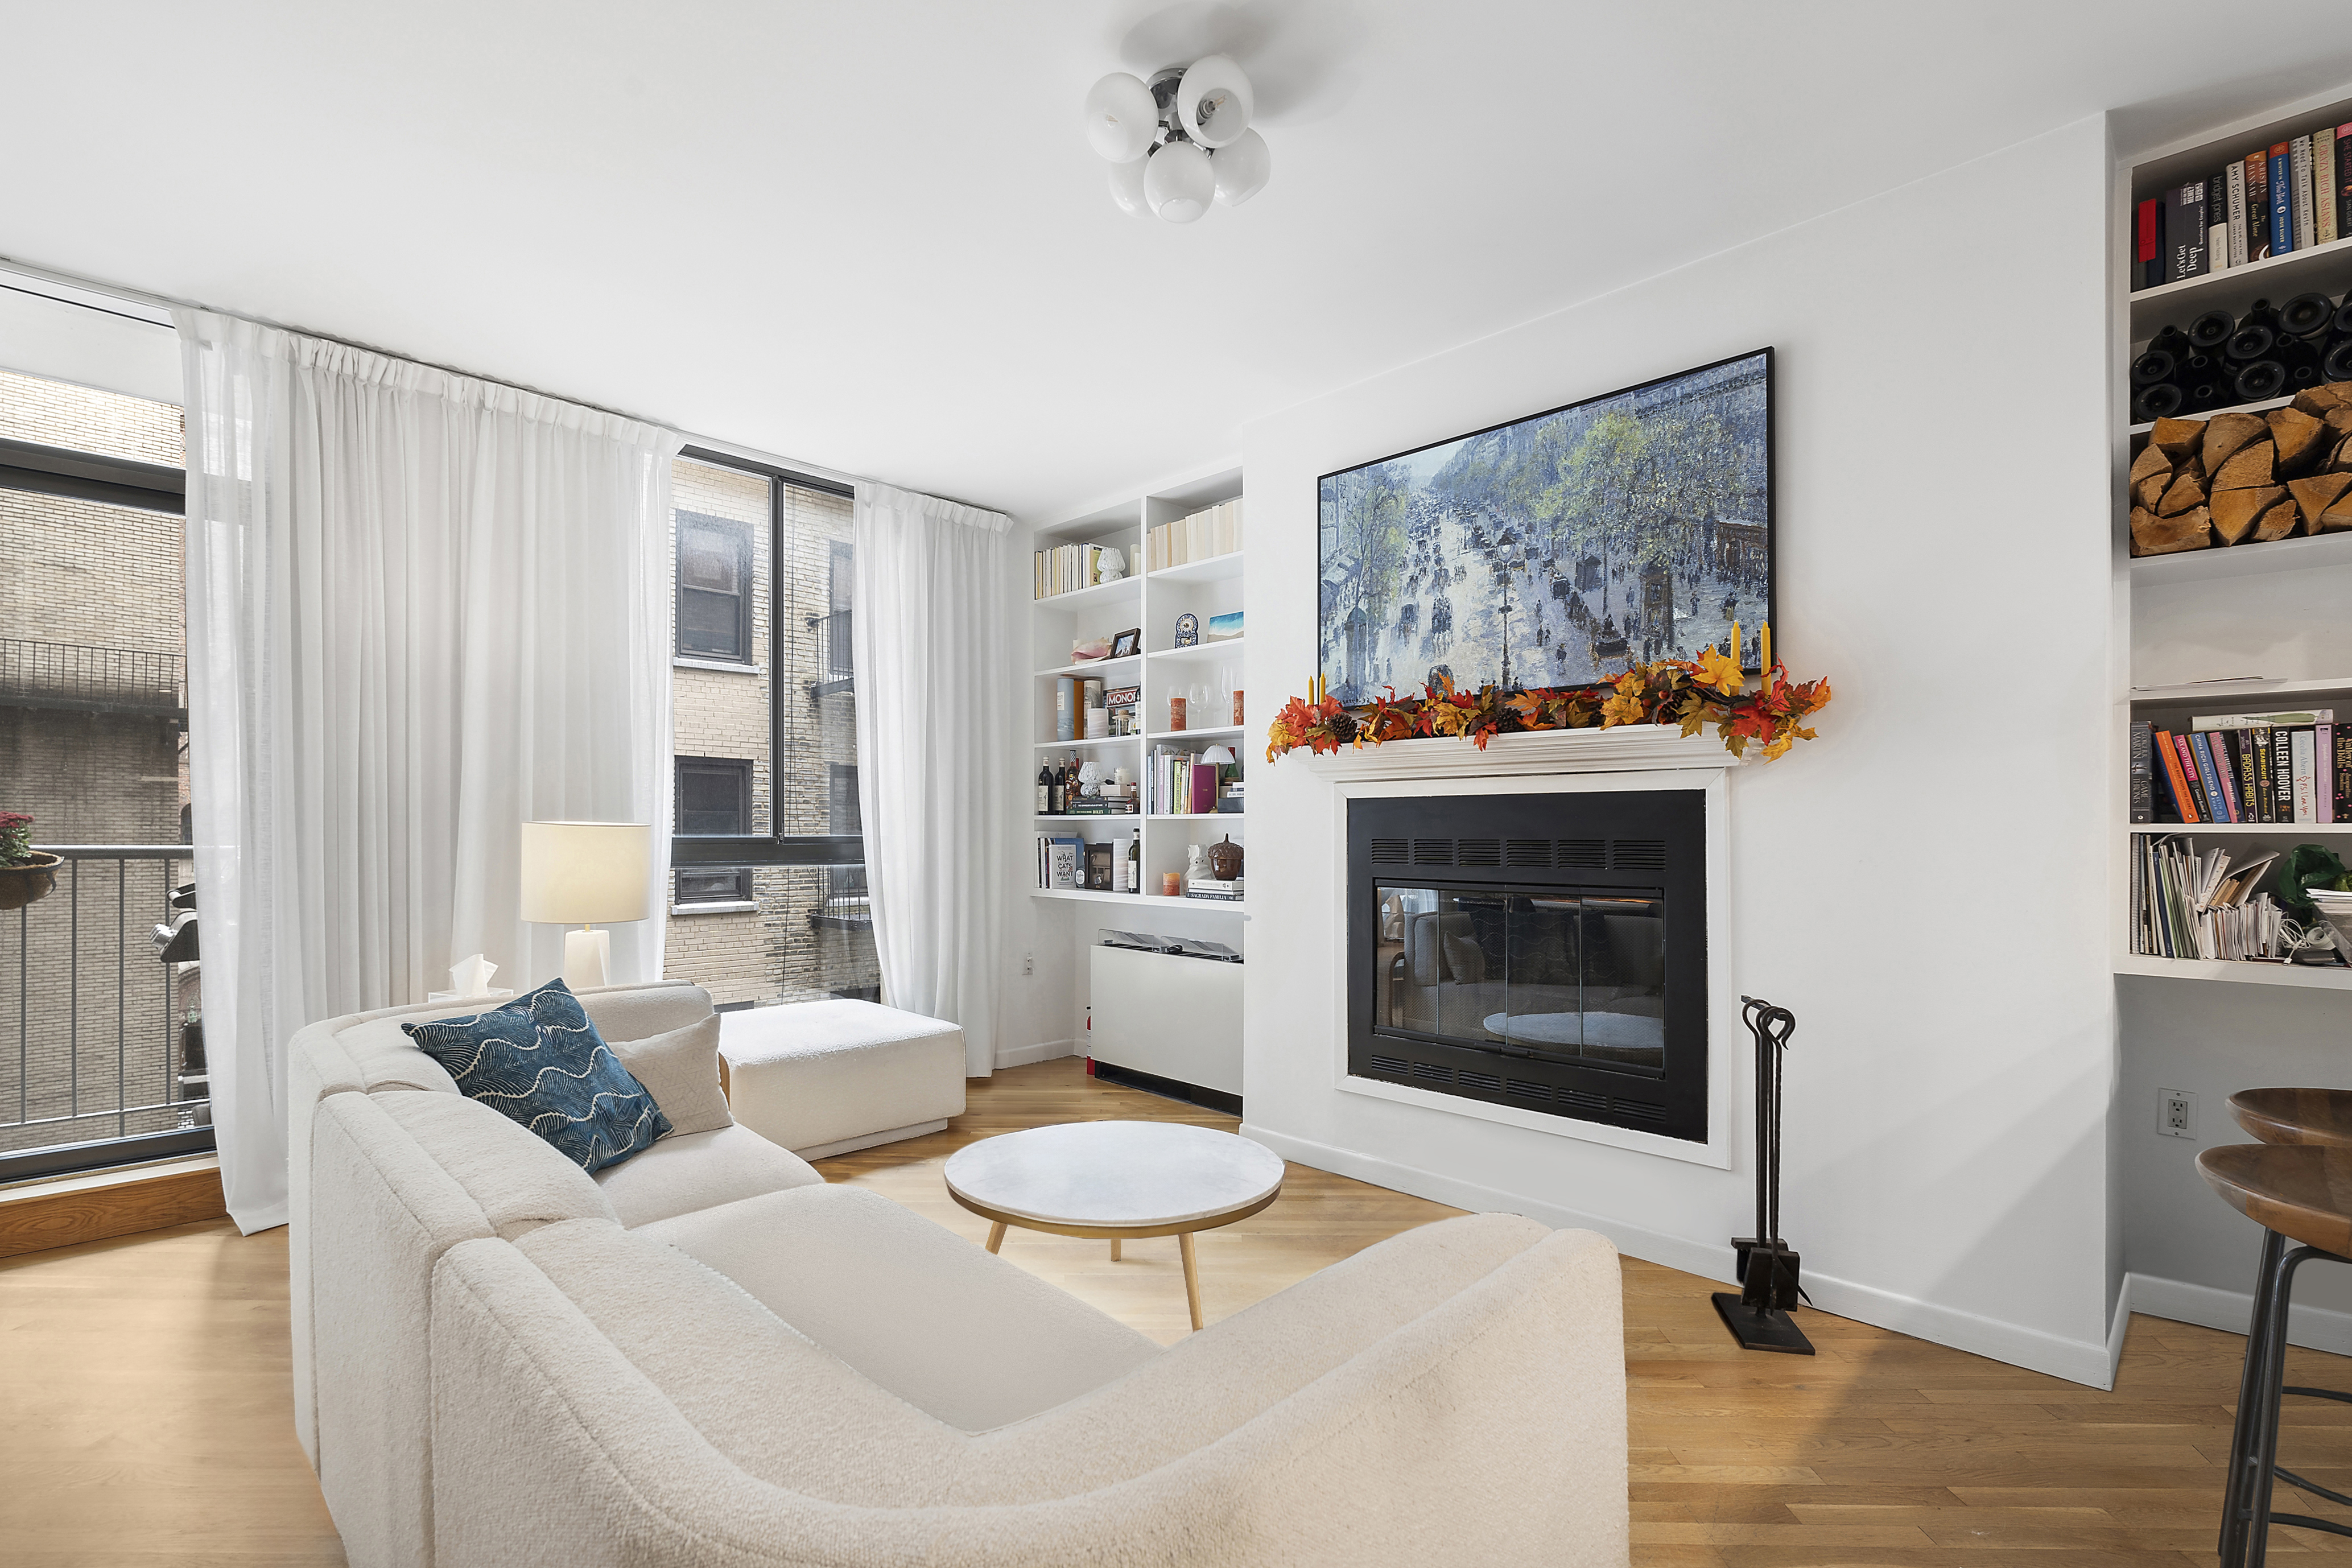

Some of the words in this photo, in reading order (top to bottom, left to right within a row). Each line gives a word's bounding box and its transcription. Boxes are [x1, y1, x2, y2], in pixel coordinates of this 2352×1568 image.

[2319, 145, 2328, 171] CRAZY
[2231, 166, 2239, 181] AMY
[2248, 164, 2256, 197] HANNAH
[2259, 162, 2267, 193] KRISTIN
[2320, 174, 2329, 195] RICH
[2211, 176, 2223, 203] bridget
[2211, 203, 2223, 222] jones
[2231, 184, 2240, 221] SCHUMER
[2251, 203, 2259, 221] Great
[2321, 197, 2330, 228] ASIANS
[2251, 221, 2260, 237] Alone
[2177, 245, 2186, 259] Get
[2186, 247, 2204, 272] Deep
[2177, 259, 2186, 279] Let's
[2275, 731, 2289, 766] COLLEEN
[2337, 749, 2345, 769] Dolls
[2186, 767, 2196, 779] CITY
[2194, 734, 2204, 750] CHINA
[2202, 762, 2215, 791] GIRLFRIEND
[2242, 754, 2252, 782] BADASS
[2244, 783, 2255, 807] HABITS
[2277, 769, 2291, 801] HOOVER
